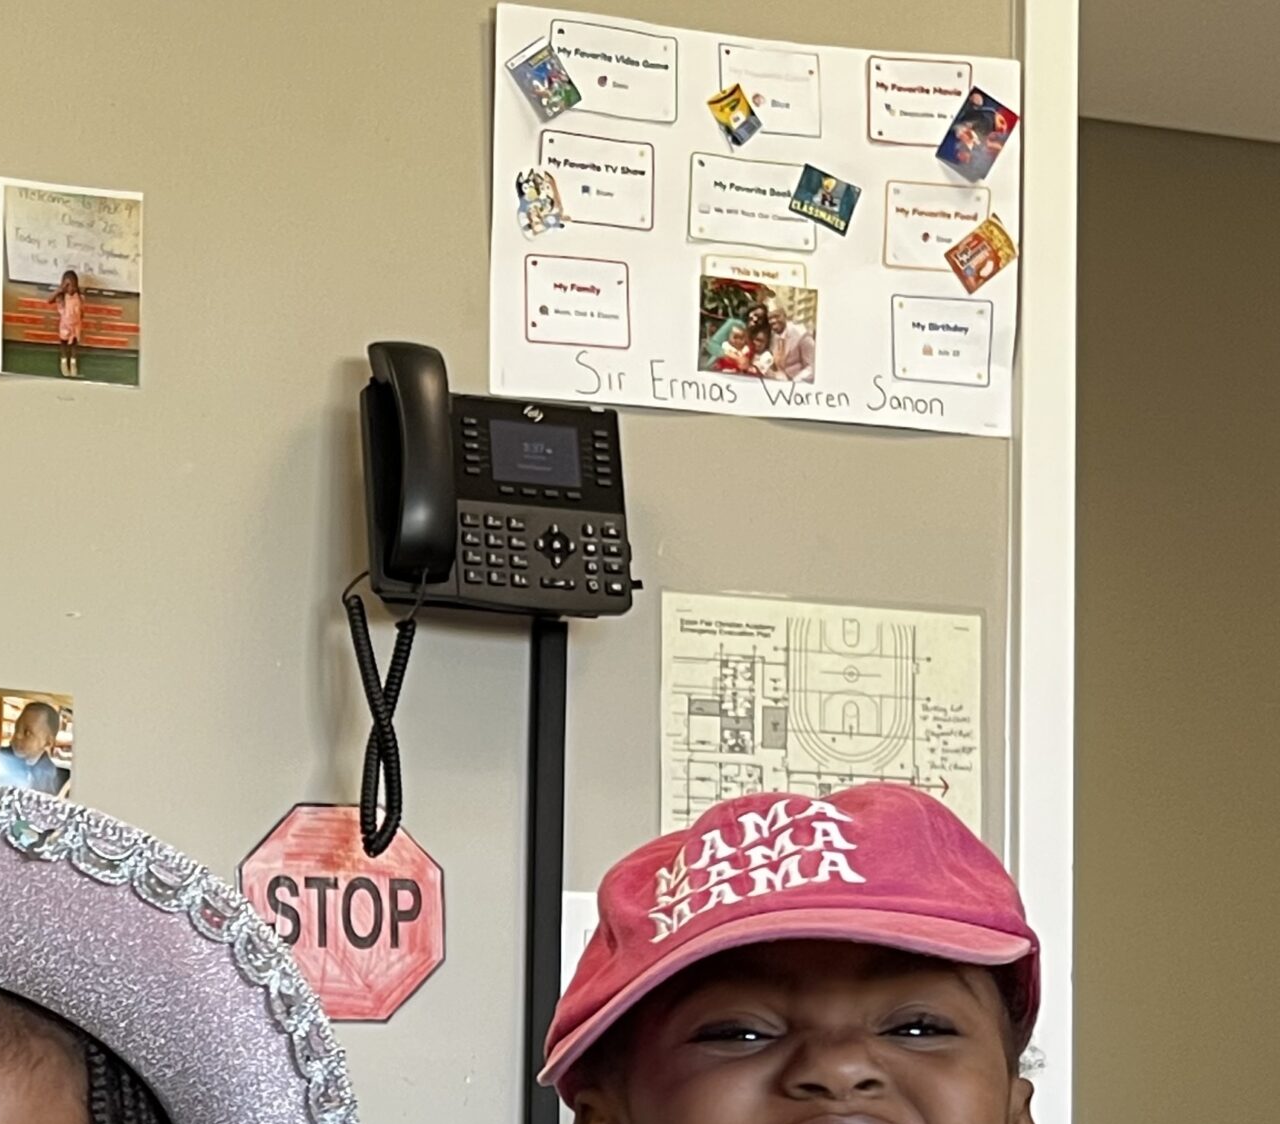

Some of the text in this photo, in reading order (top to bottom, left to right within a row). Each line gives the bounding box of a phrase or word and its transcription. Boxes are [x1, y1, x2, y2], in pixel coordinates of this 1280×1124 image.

[557, 46, 571, 58] My
[574, 48, 612, 63] Favorite
[616, 55, 640, 67] Video
[643, 60, 669, 70] Game
[876, 81, 962, 97] My Favorite Movie
[548, 157, 646, 176] My Favorite TV Show
[714, 180, 727, 191] My
[729, 183, 767, 196] Favorite
[895, 206, 978, 221] My Favorite Food
[553, 282, 601, 296] My Family
[911, 320, 970, 336] My Birthday
[575, 350, 944, 417] Sir Ermias Warren Sanon
[654, 799, 854, 898] MAMA
[647, 821, 858, 916] MAMA
[648, 851, 867, 944] MAMA
[266, 875, 423, 949] STOP
